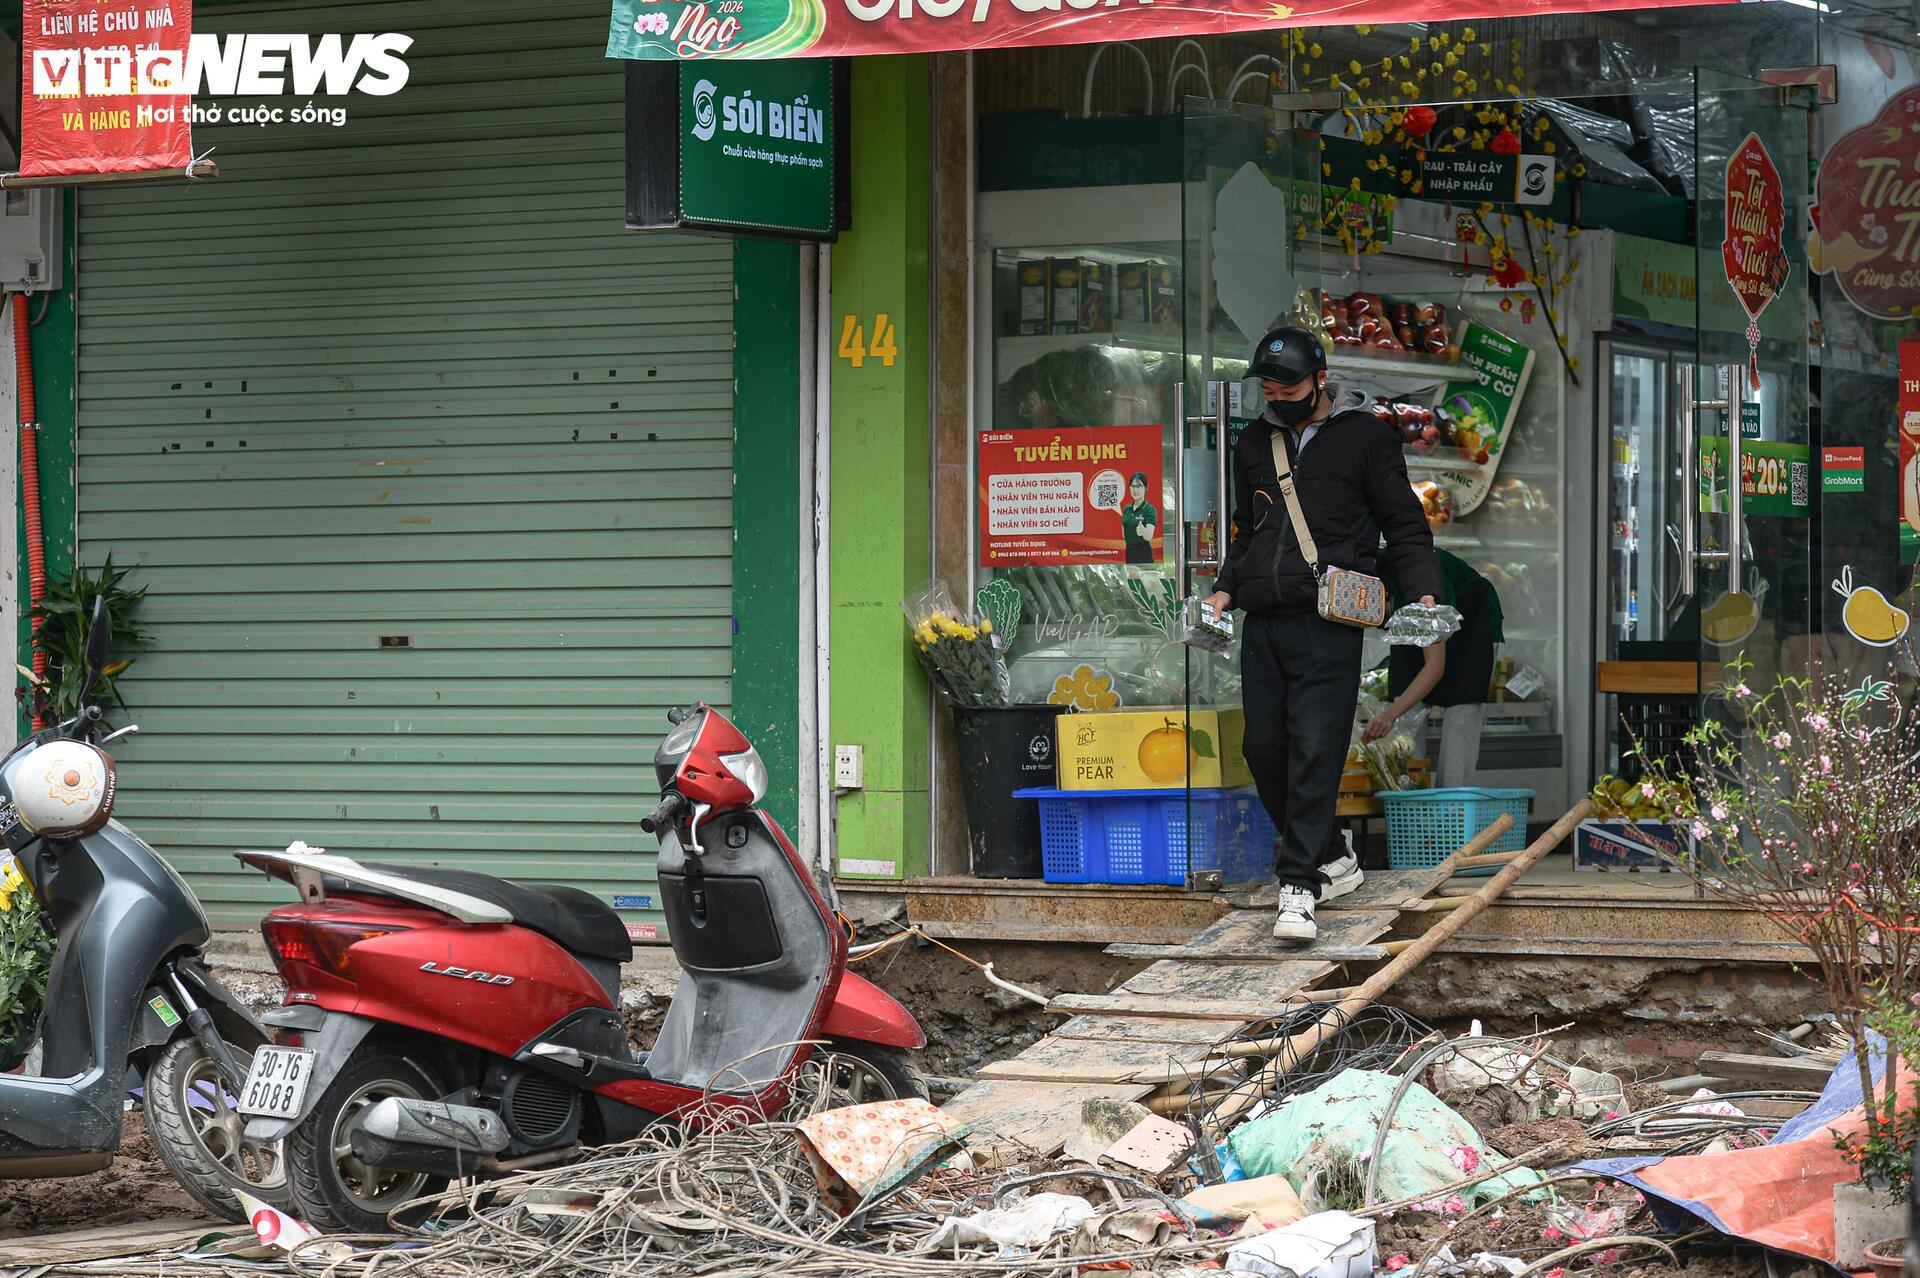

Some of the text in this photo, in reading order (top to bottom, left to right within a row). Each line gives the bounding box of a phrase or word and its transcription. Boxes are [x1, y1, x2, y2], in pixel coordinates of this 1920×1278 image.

[717, 1, 743, 14] 2026
[42, 4, 174, 36] LIÊN HỆ CHỦ NHÀ
[62, 109, 84, 130] VÀ
[90, 107, 130, 130] HÀNG
[722, 90, 823, 144] SÓI BIỂN
[723, 144, 823, 170] Chuỗi cửa hàng thực phẩm sạch
[1424, 162, 1444, 172] RAU
[1453, 160, 1476, 172] TRÁI
[1479, 162, 1502, 174] CÂY
[1430, 176, 1493, 192] NHẬP KHẨU
[839, 314, 897, 368] 44
[1014, 436, 1126, 464] TUYỂN DỤNG
[996, 478, 1072, 488] CỬA HÀNG TRƯỞNG
[996, 493, 1018, 501] NHÂN
[1020, 492, 1038, 500] VIÊN
[1056, 491, 1079, 500] NGÂN
[996, 505, 1080, 515] NHÂN VIÊN BÁN HÀNG
[996, 520, 1018, 528] NHÂN
[1020, 519, 1038, 528] VIÊN
[1052, 517, 1068, 527] CHẾ
[1034, 607, 1120, 648] VietGAP
[1076, 756, 1114, 765] PREMIUM
[1077, 766, 1114, 780] PEAR
[419, 961, 516, 986] LEAD
[258, 1050, 302, 1081] 30-Y6
[248, 1081, 294, 1111] 6088
